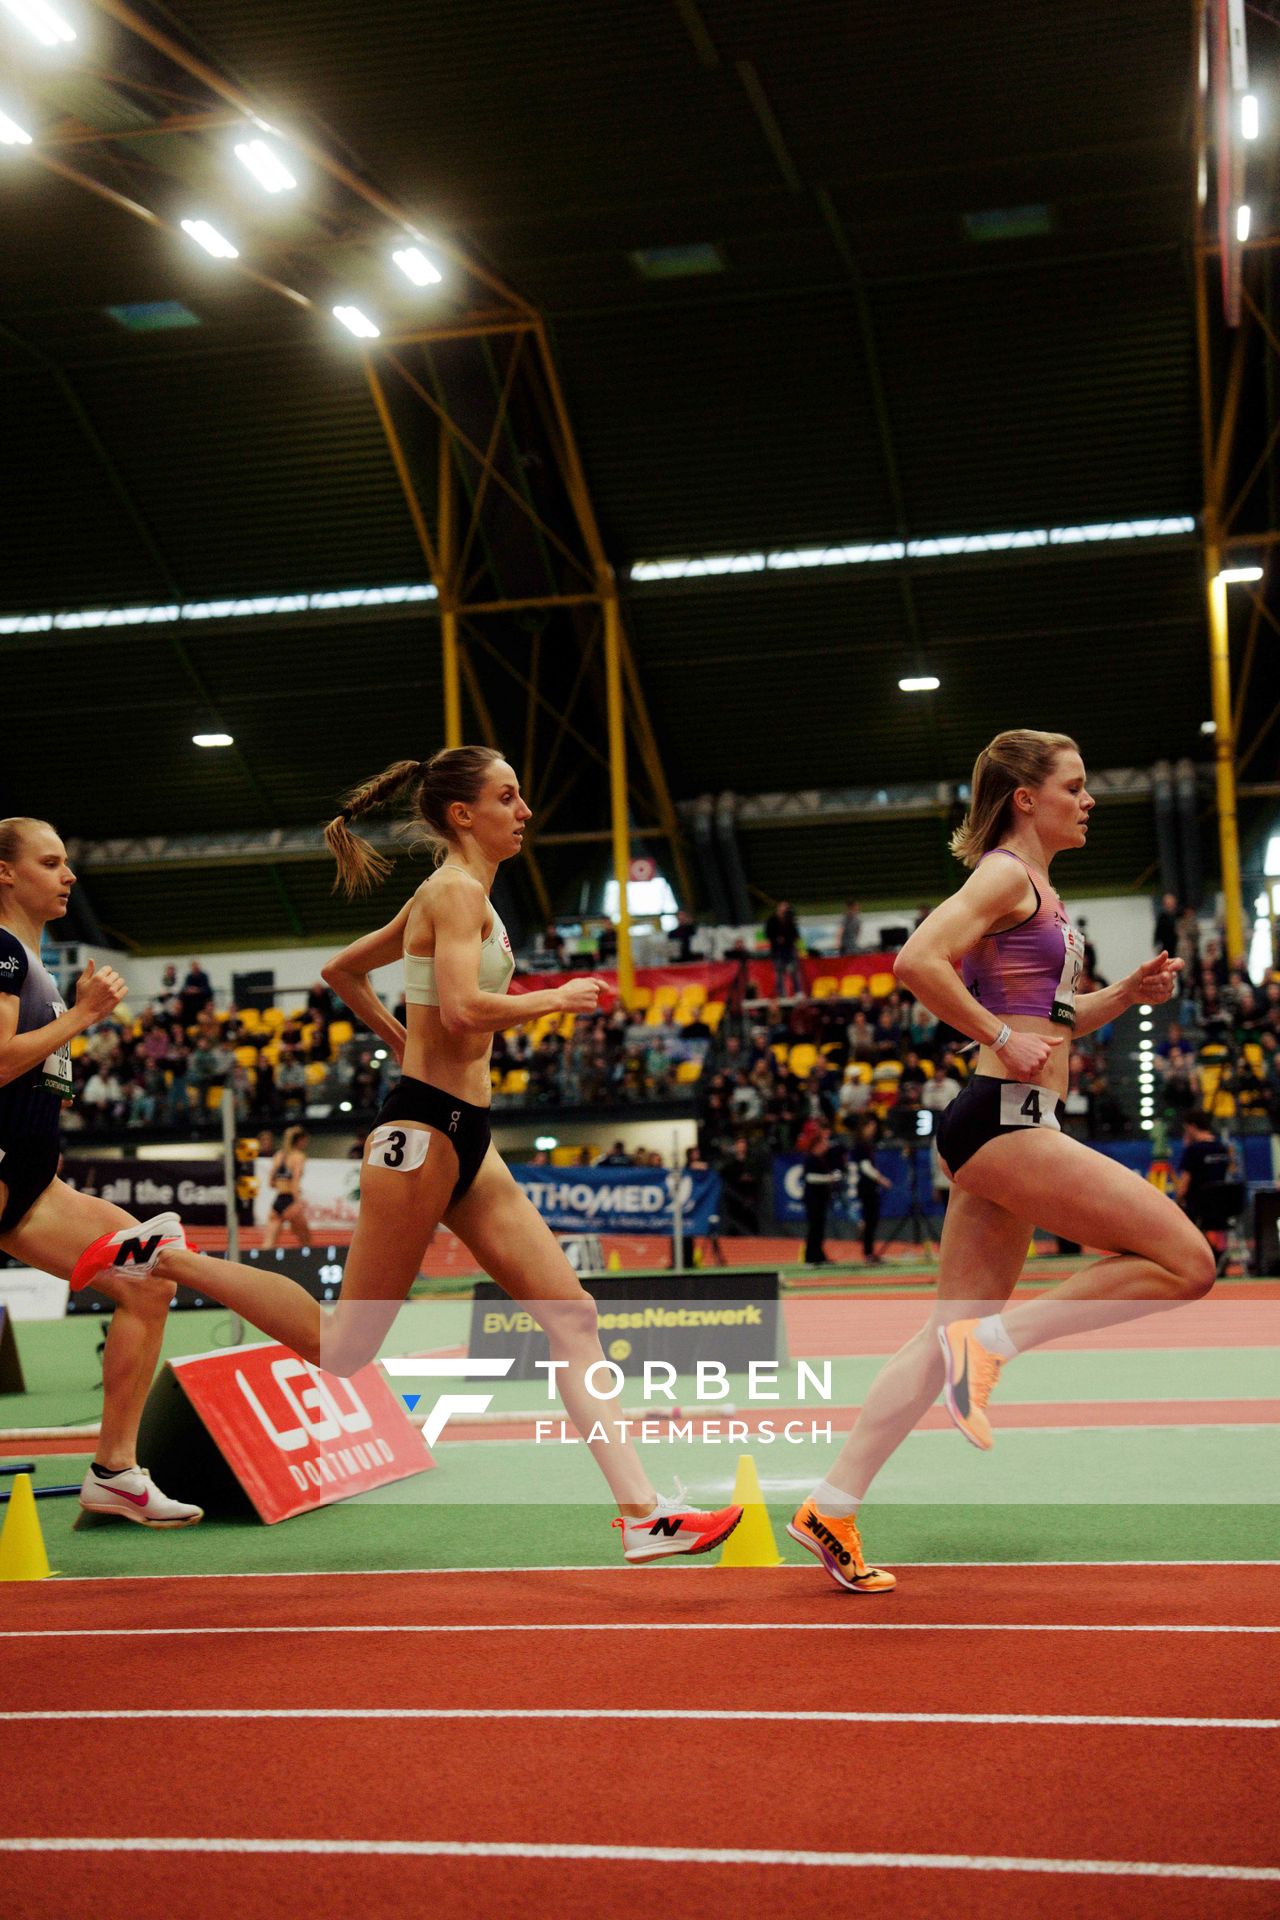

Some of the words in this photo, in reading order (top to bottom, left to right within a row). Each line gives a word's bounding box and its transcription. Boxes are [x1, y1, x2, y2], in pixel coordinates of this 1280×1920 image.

[1020, 1089, 1042, 1124] 4
[383, 1130, 407, 1168] 3
[102, 1178, 132, 1204] all
[135, 1179, 174, 1205] the
[177, 1180, 229, 1206] Gam
[113, 1234, 164, 1267] N
[288, 1438, 395, 1492] DORTMUND
[648, 1517, 684, 1537] N
[801, 1509, 852, 1566] NITRO
